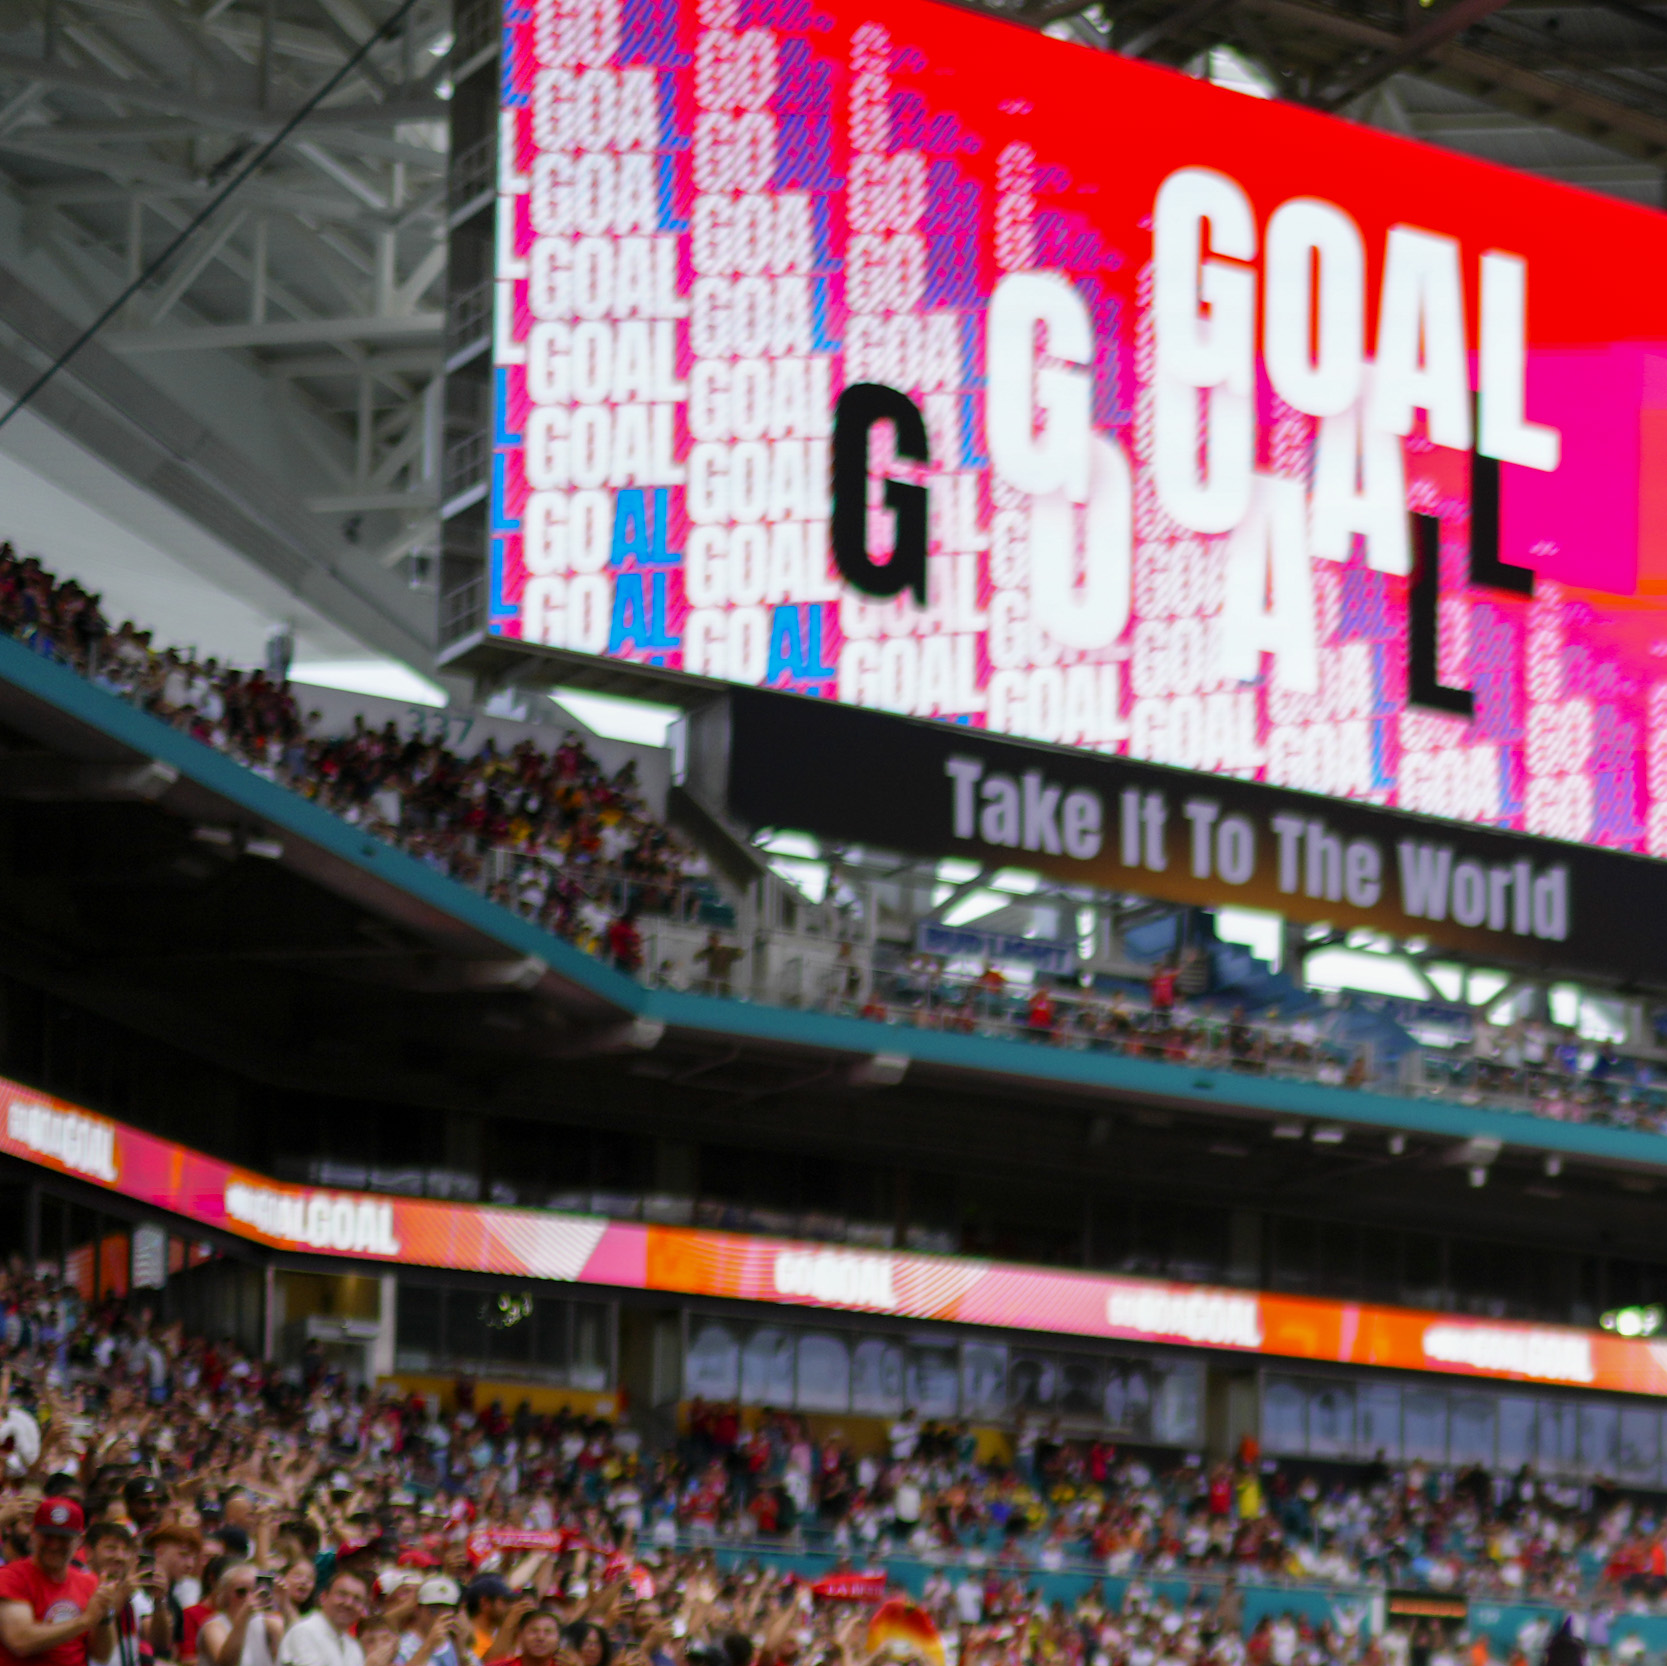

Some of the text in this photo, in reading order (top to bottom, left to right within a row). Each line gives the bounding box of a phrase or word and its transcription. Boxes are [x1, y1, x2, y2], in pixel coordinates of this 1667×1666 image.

[1152, 165, 1561, 472] GOAL
[946, 757, 1570, 941] Take It To The World
